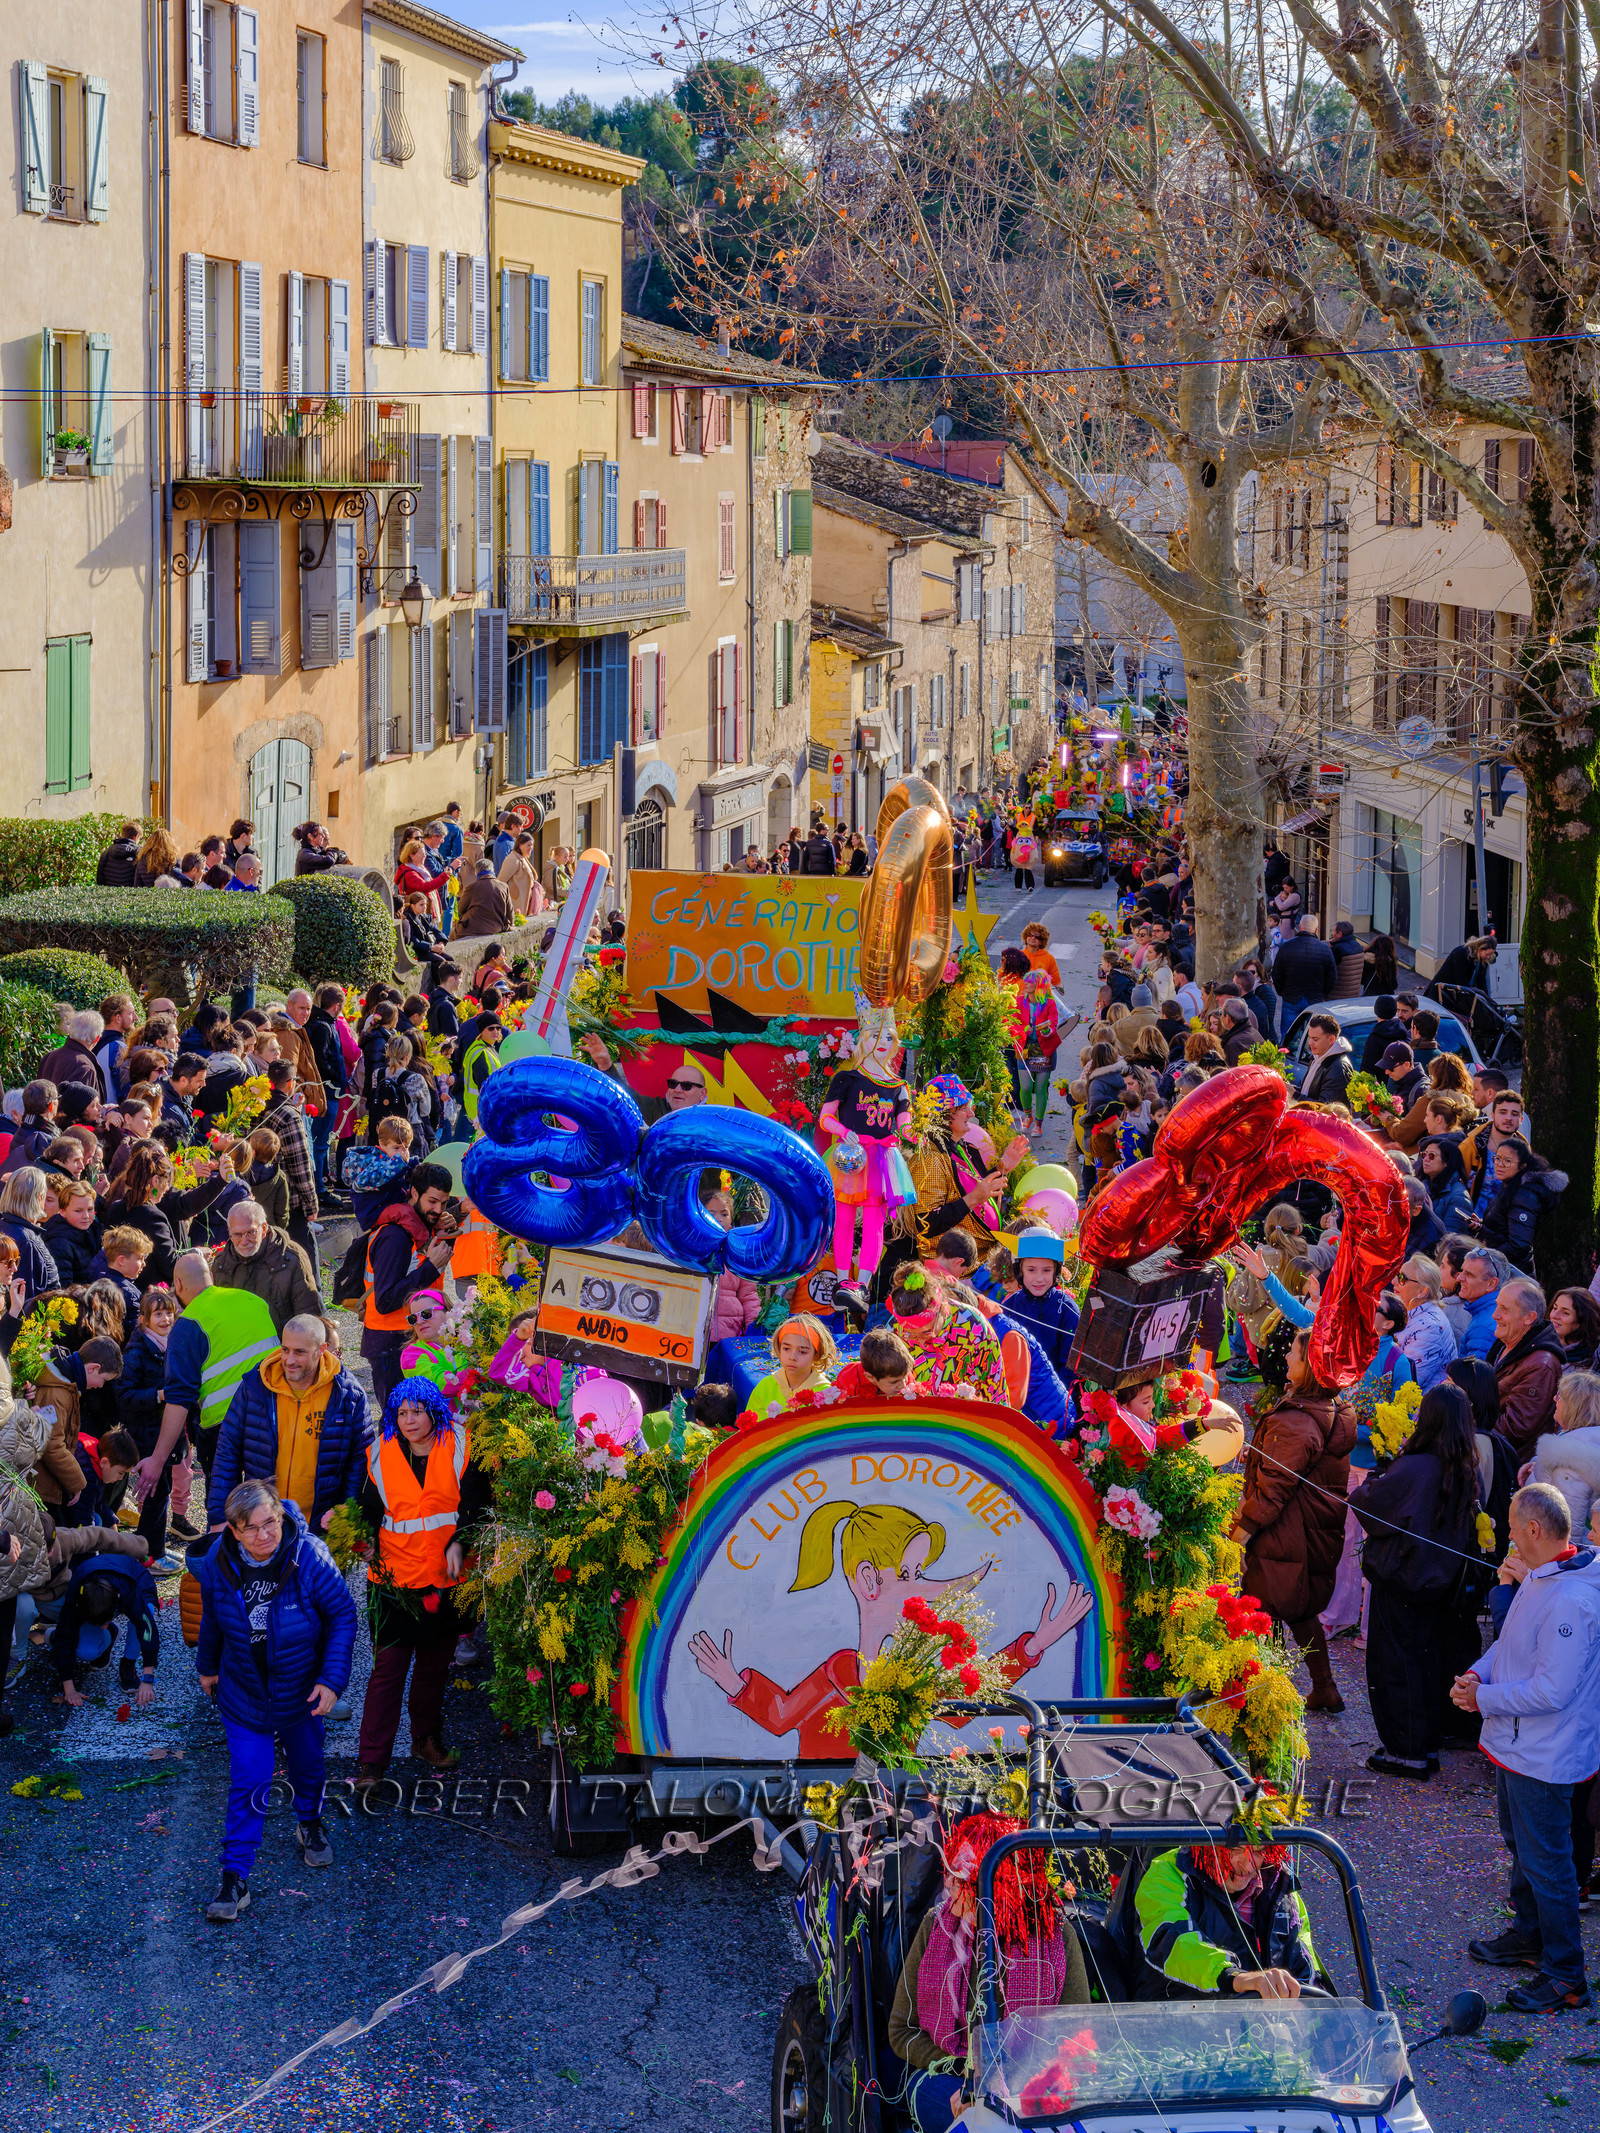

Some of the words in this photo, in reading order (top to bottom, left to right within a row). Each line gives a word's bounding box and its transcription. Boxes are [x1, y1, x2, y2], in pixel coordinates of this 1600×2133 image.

[511, 798, 535, 809] BARNES
[649, 886, 859, 941] GÉNÉRATIO
[551, 1277, 566, 1297] A
[1151, 1312, 1180, 1343] VHS
[726, 1467, 829, 1571] CLUB
